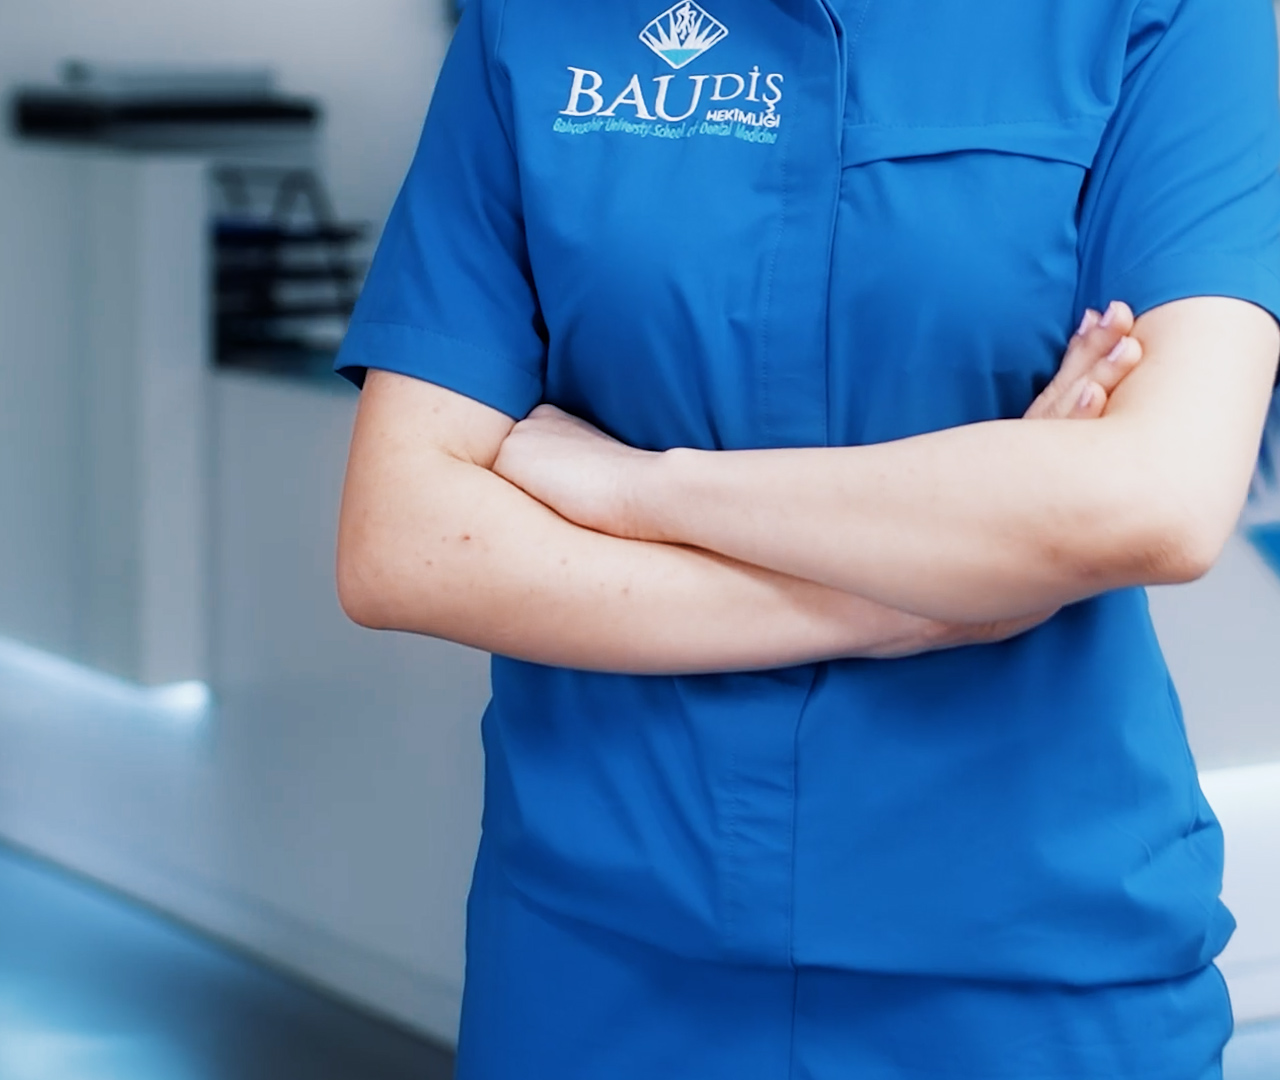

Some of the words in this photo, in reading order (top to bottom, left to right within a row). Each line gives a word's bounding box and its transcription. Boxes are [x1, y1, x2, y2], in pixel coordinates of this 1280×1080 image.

[559, 66, 709, 122] BAU
[710, 65, 785, 113] DİŞ
[650, 122, 686, 139] School
[700, 120, 733, 136] Dental
